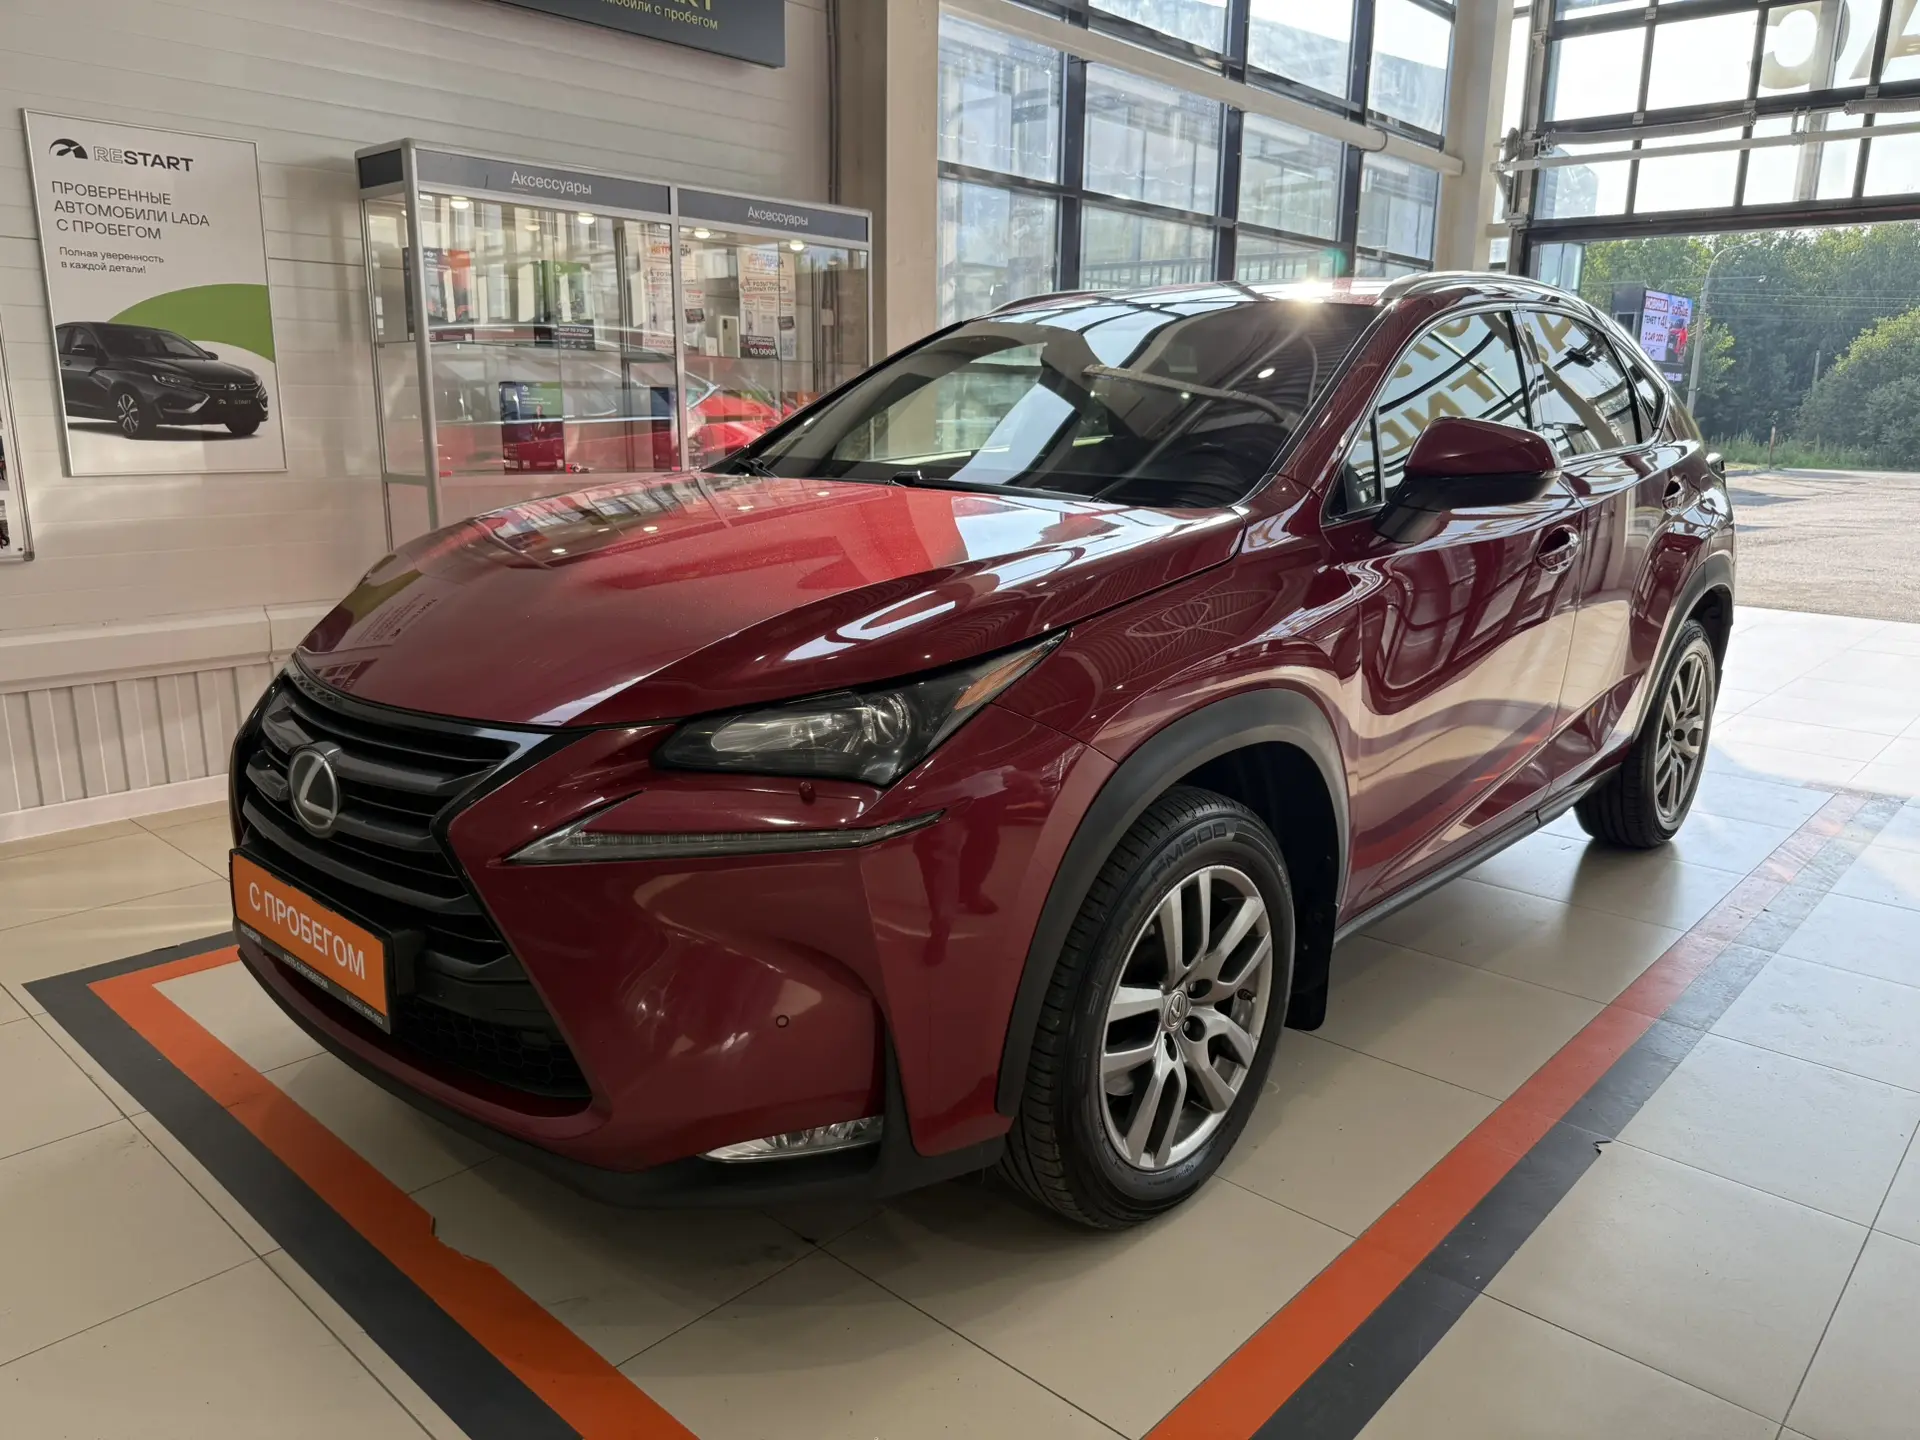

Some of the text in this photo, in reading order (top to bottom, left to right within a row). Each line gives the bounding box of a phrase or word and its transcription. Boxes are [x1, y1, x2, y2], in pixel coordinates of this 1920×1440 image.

[654, 5, 661, 15] с
[664, 8, 718, 30] пробегом
[93, 146, 194, 172] RESTART
[52, 180, 172, 206] ПРОВЕРЕННЫЕ
[511, 171, 592, 195] Аксессуары
[54, 200, 210, 227] АВТОМОБИЛИ LADA
[747, 206, 809, 227] Аксессуары
[56, 218, 162, 240] С ПРОБЕГОМ
[59, 246, 164, 264] Полная уверенность
[70, 261, 107, 272] каждой
[109, 264, 147, 274] детали!
[249, 882, 366, 980] С ПРОБЕГОМ
